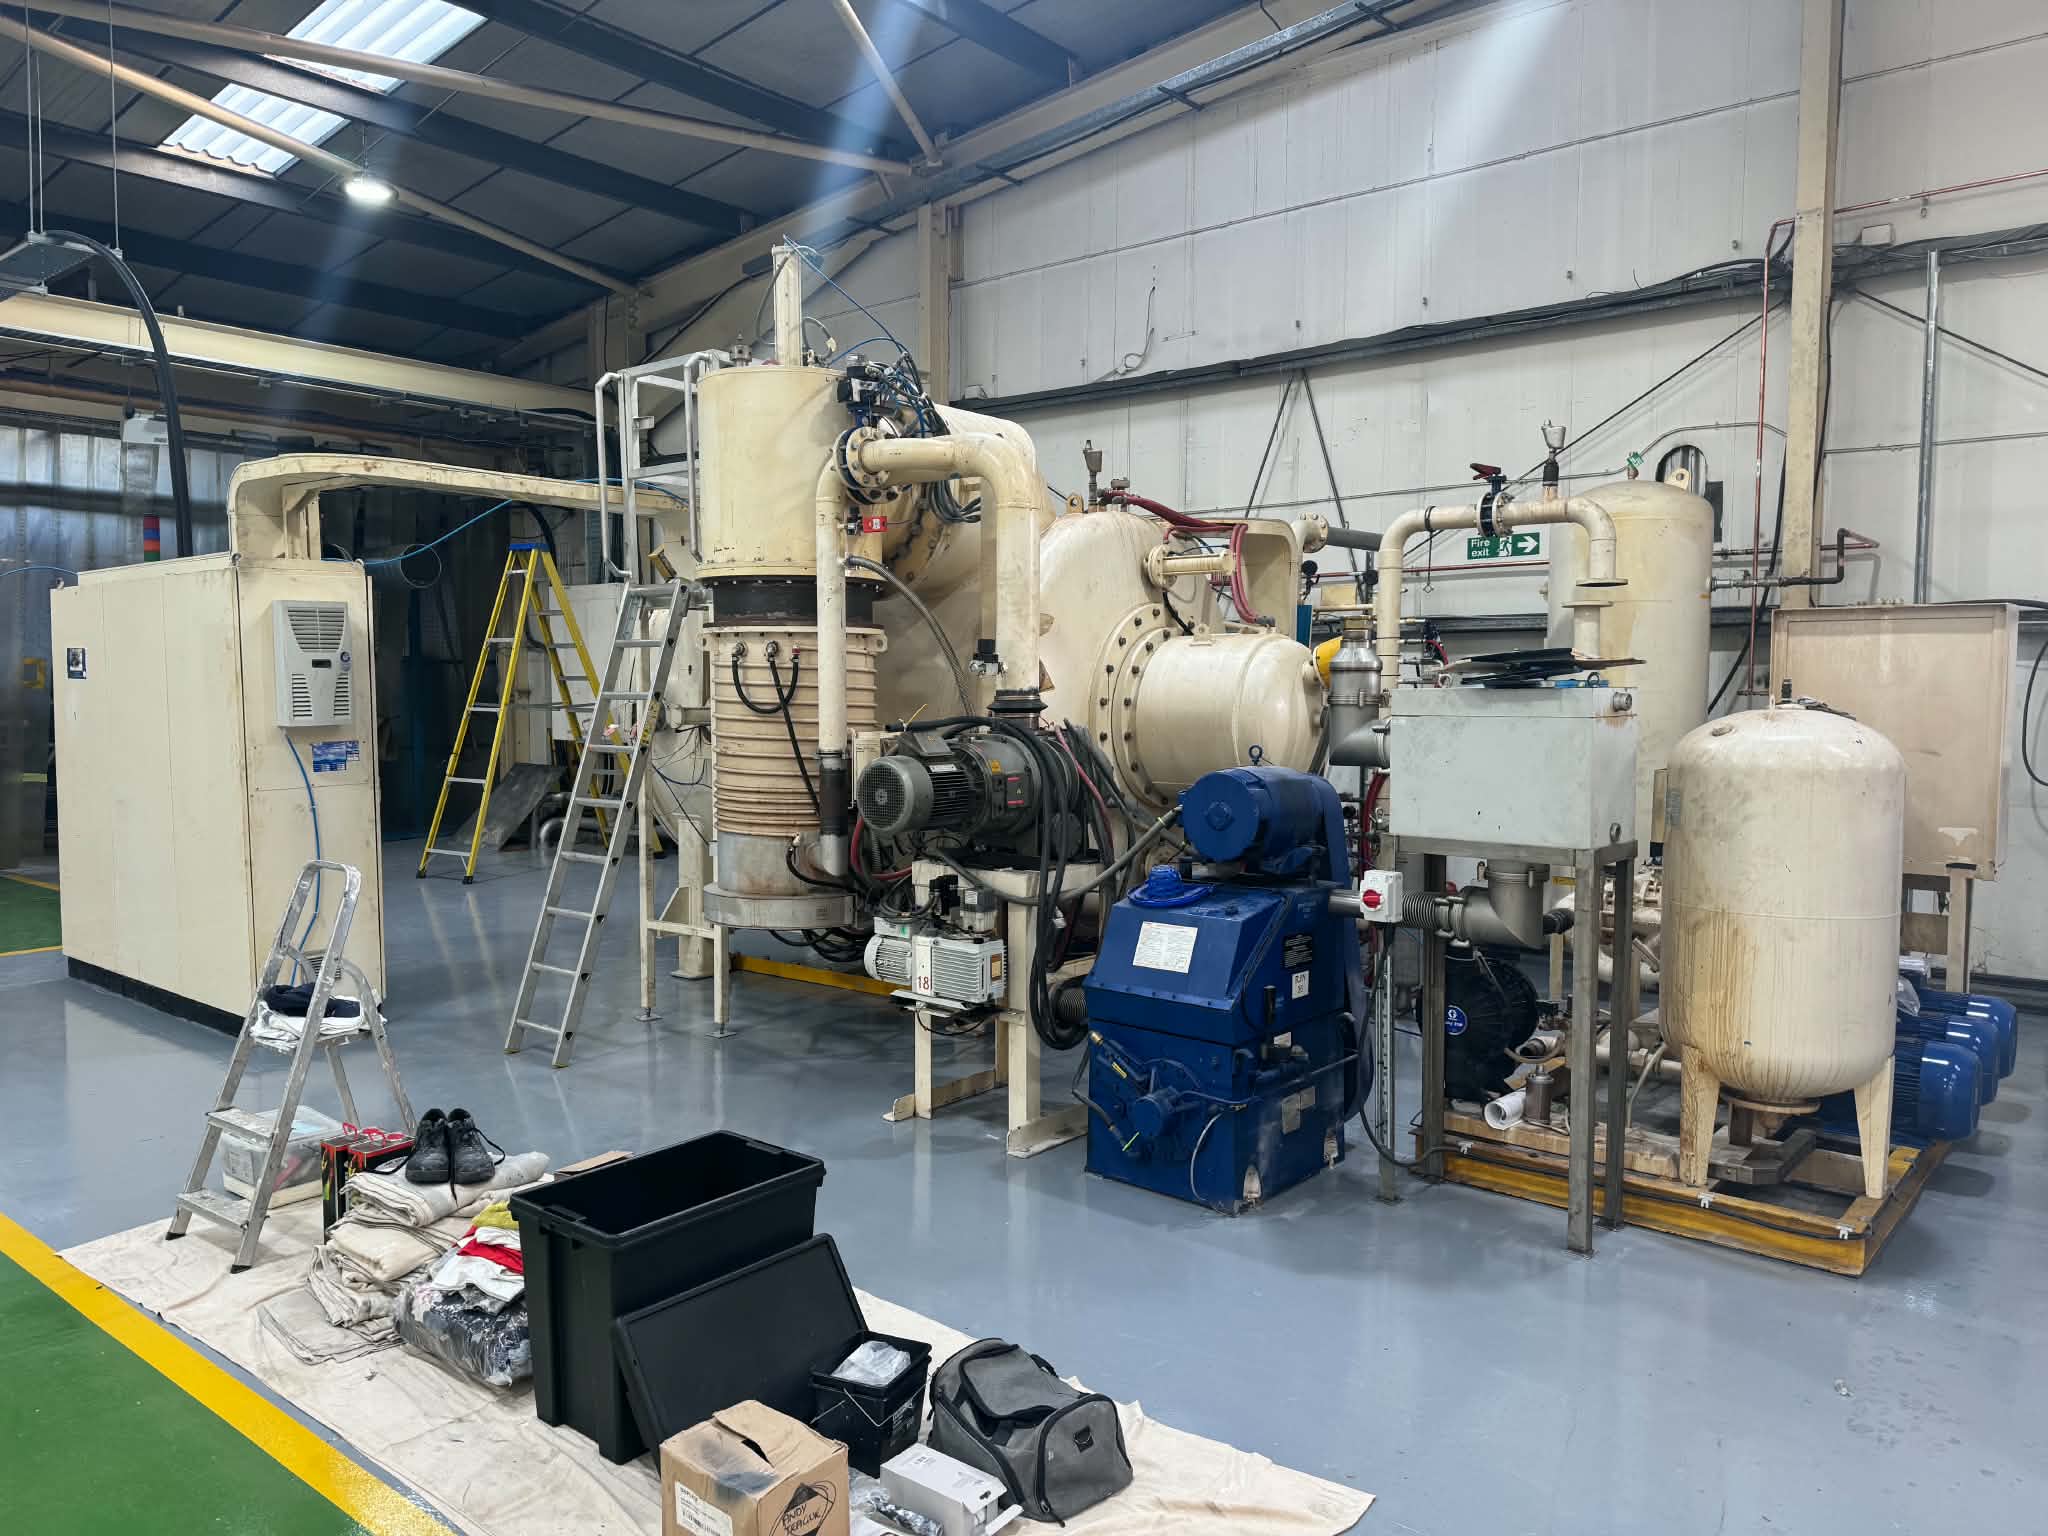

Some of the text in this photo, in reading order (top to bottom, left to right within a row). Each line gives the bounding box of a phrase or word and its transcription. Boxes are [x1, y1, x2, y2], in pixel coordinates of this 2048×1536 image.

[1471, 538, 1490, 548] Fire
[1471, 548, 1489, 557] exit
[918, 975, 930, 990] 18
[783, 1503, 806, 1526] ANDY
